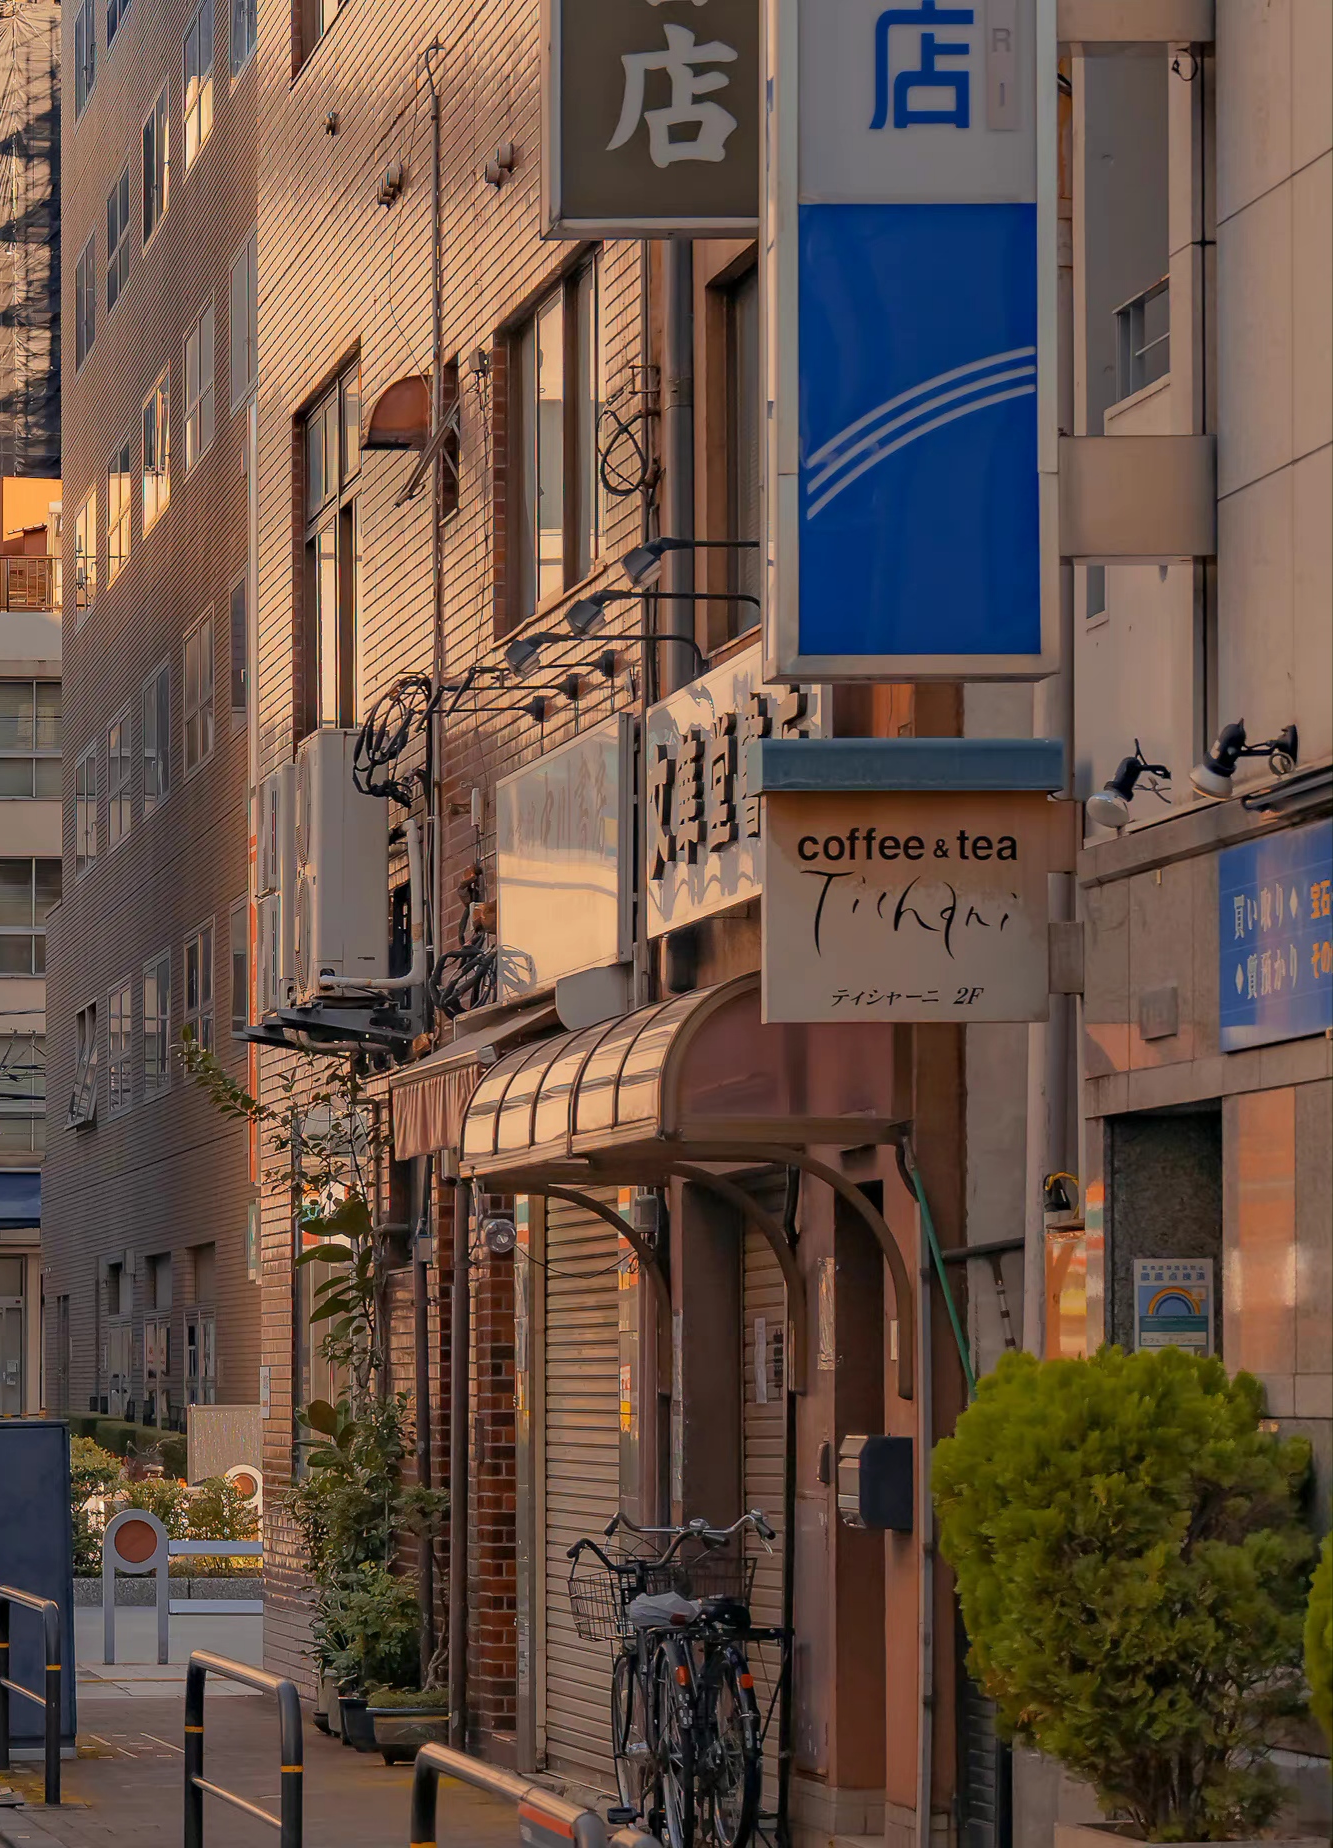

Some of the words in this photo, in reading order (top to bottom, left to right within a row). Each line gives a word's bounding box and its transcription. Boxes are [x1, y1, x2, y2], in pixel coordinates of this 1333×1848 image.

[606, 0, 737, 168] 店
[869, 0, 974, 130] 店
[797, 828, 925, 861] coffee
[933, 840, 950, 859] &
[956, 829, 1018, 861] tea
[831, 988, 940, 1007] ティシャーニ
[952, 986, 985, 1005] 2F
